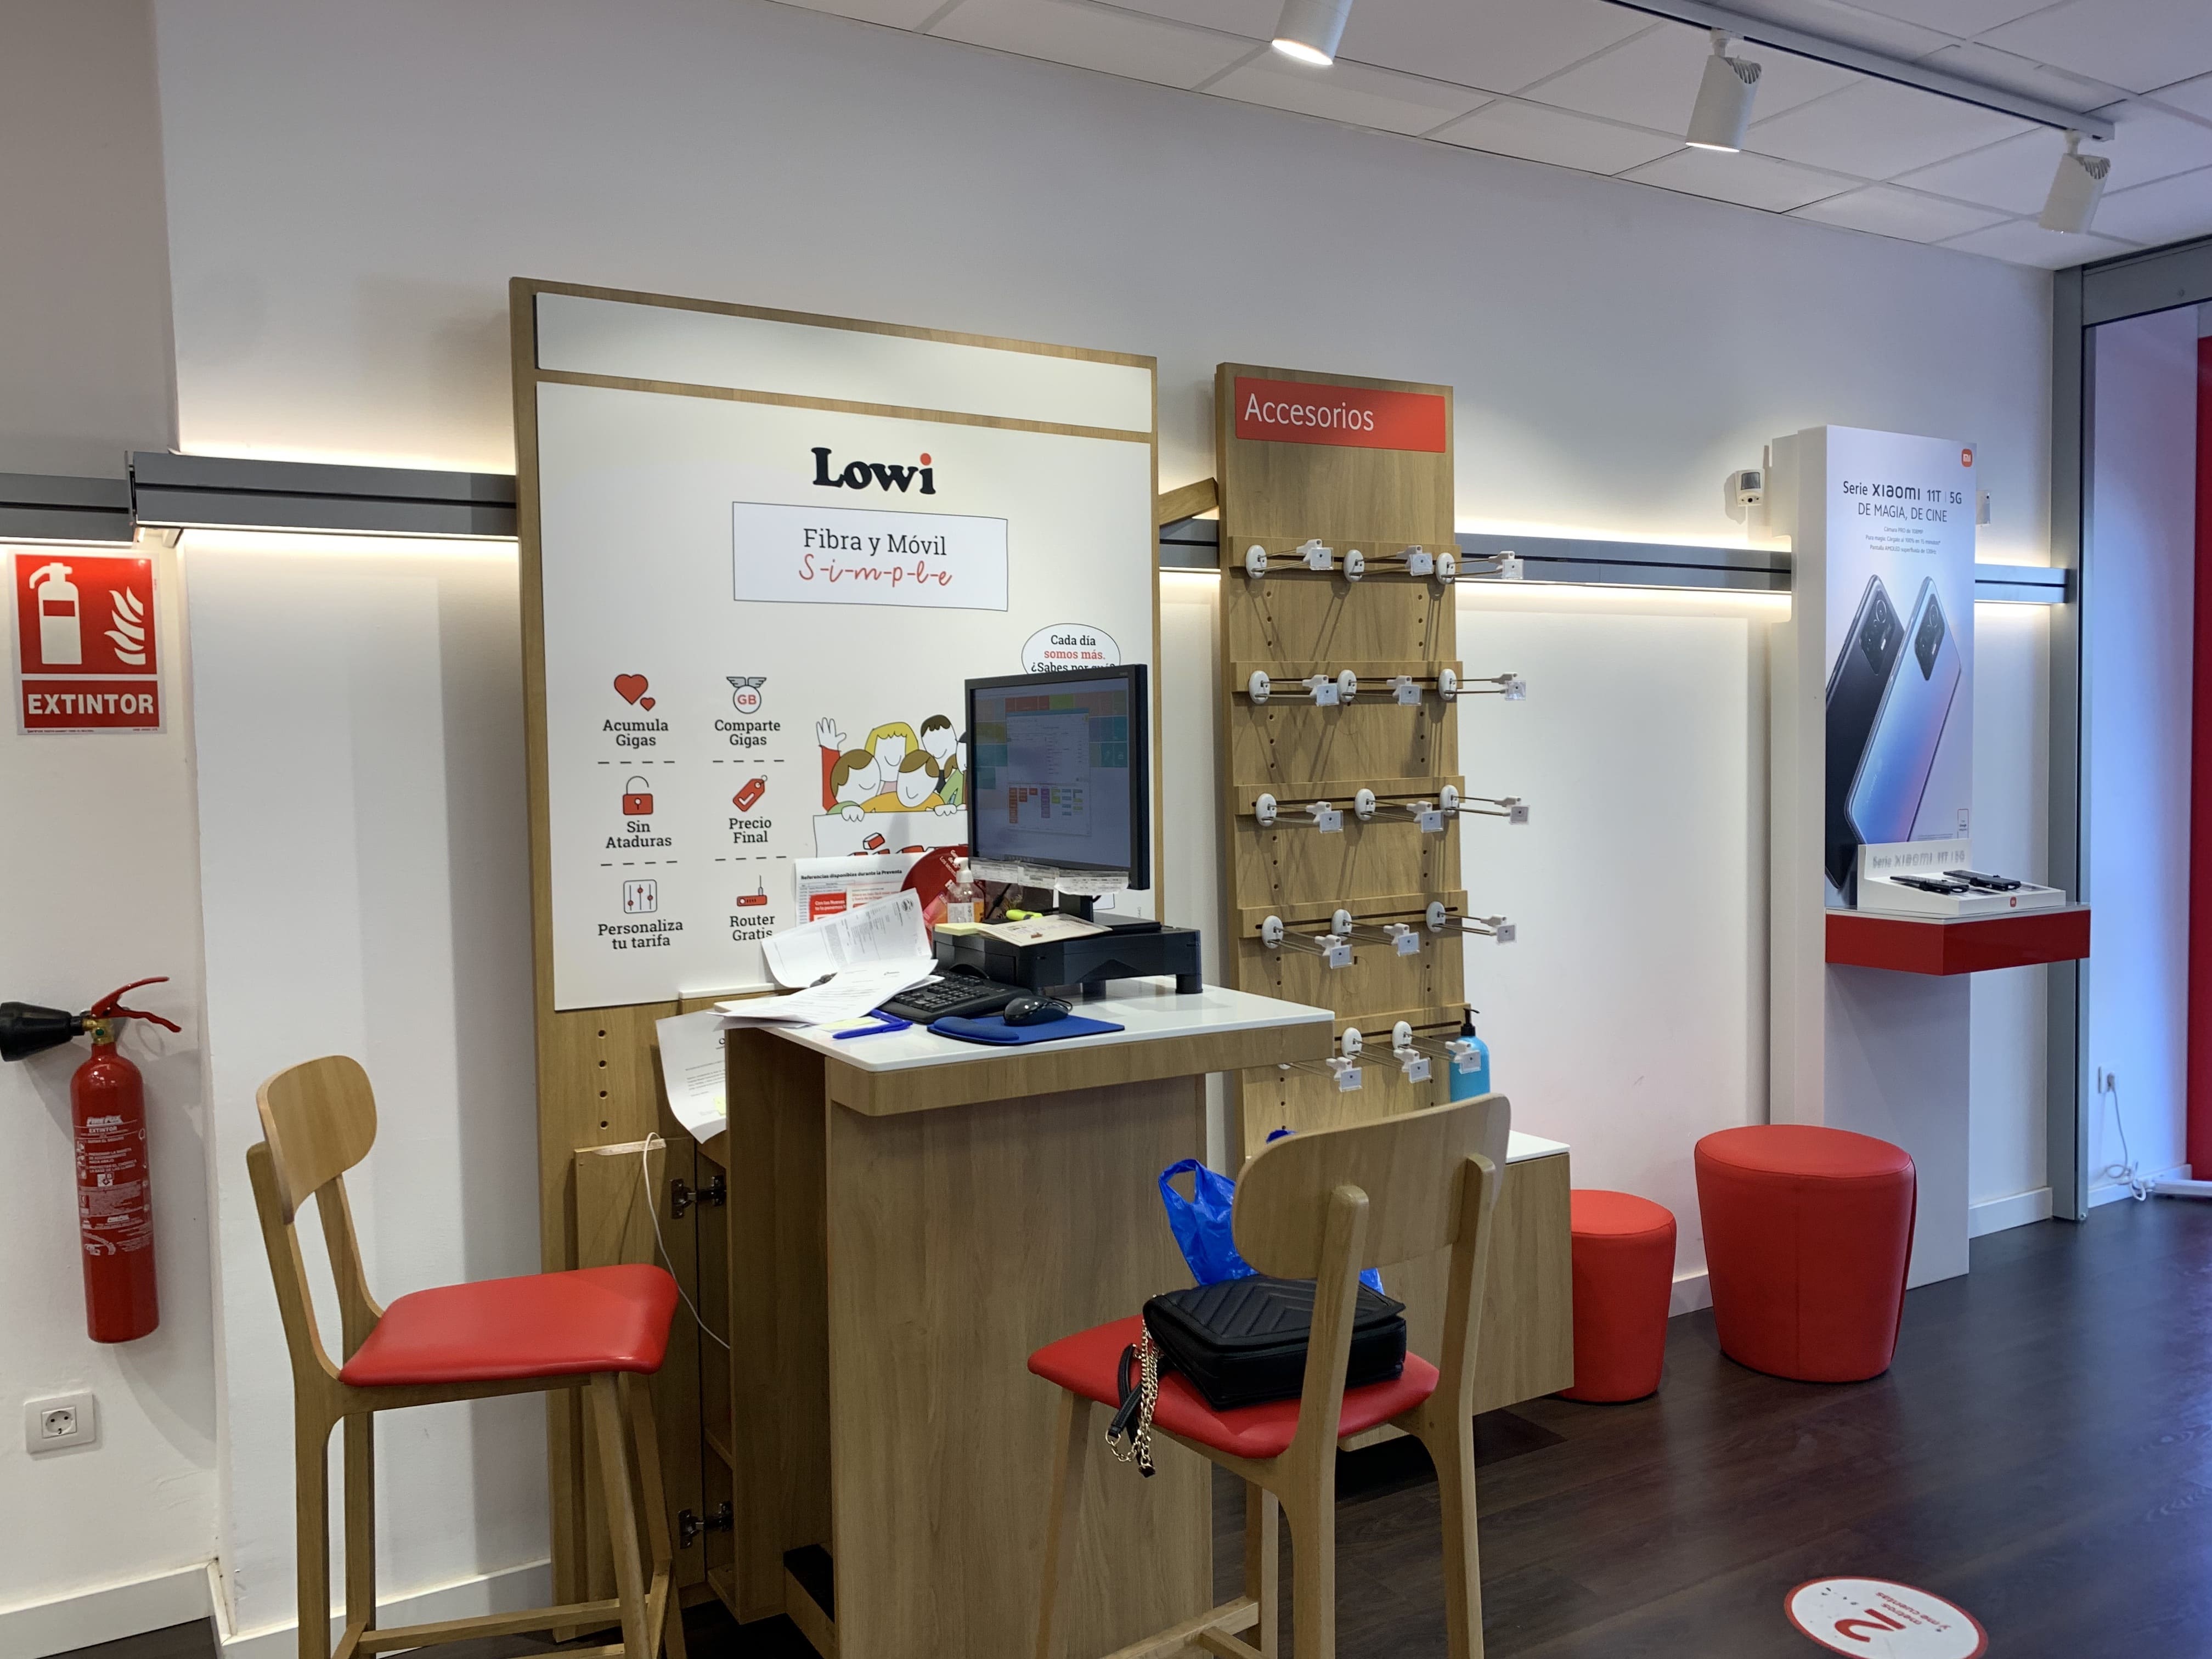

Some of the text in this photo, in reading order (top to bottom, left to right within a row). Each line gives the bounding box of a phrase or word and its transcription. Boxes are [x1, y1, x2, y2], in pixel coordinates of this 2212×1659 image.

[1244, 393, 1374, 431] Accesorios
[811, 447, 936, 495] Lowi
[1843, 481, 1868, 495] Serie
[1927, 489, 1942, 503] 11T
[1950, 492, 1962, 504] 5G
[1858, 502, 1948, 522] DE MAGIA, DE CINE
[803, 528, 947, 556] Fibra y Móvil
[1051, 634, 1096, 646] Cada día
[1044, 650, 1105, 659] somos más.
[1031, 662, 1068, 672] ¿Sabes
[27, 693, 154, 714] EXTINTOR
[737, 694, 757, 706] GB
[602, 719, 669, 731] Acumula
[714, 719, 781, 733] Comparte
[616, 733, 656, 749] Gigas
[729, 733, 767, 748] Gigas
[627, 820, 651, 833] Sin
[729, 816, 772, 830] Precio
[605, 835, 672, 849] Ataduras
[733, 831, 769, 843] Final
[597, 919, 684, 936] Personaliza
[729, 915, 775, 927] Router
[732, 927, 772, 941] Gratis
[612, 934, 670, 949] tu tarifa
[1876, 1592, 1920, 1615] cuentas
[1881, 1602, 1922, 1625] metros
[1920, 1614, 1940, 1625] me
[1834, 1608, 1907, 1643] 2
